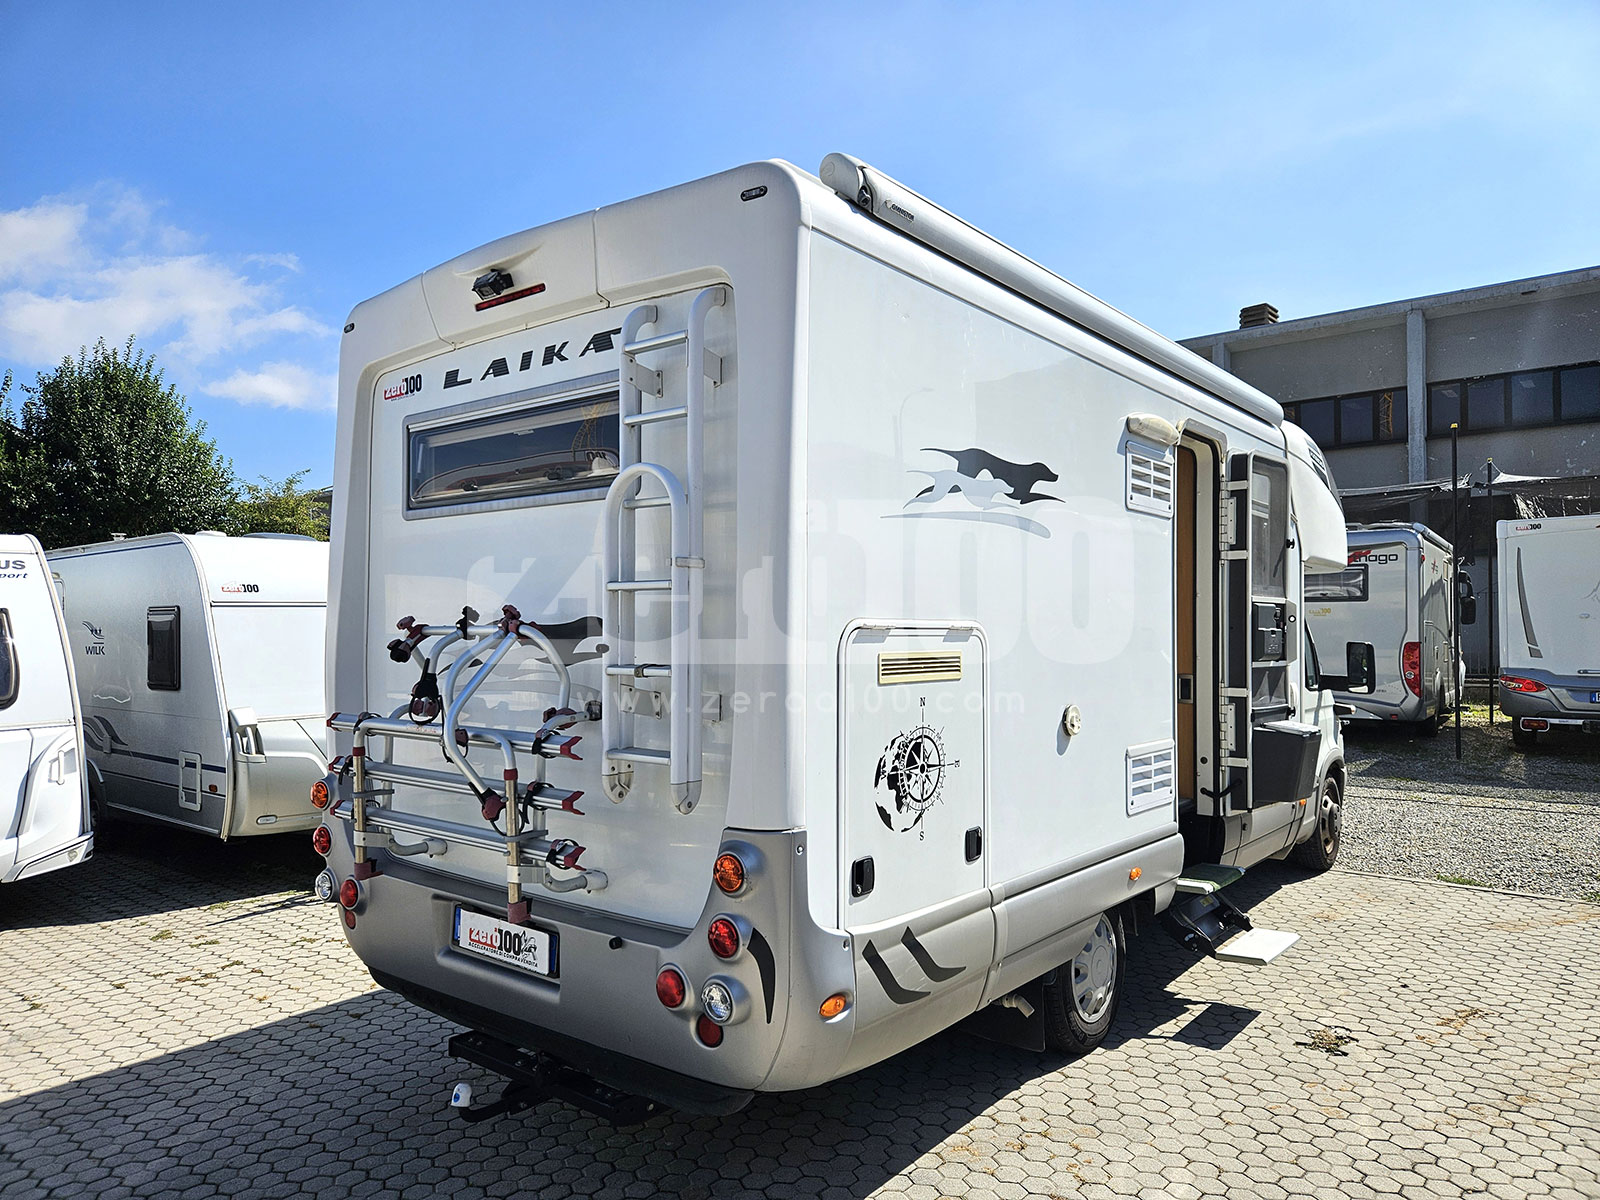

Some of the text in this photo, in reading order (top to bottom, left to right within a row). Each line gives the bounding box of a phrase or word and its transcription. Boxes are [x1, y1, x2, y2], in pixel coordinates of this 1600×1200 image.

[443, 326, 623, 390] LAIKA
[384, 373, 423, 400] zero100
[85, 645, 106, 656] WILK
